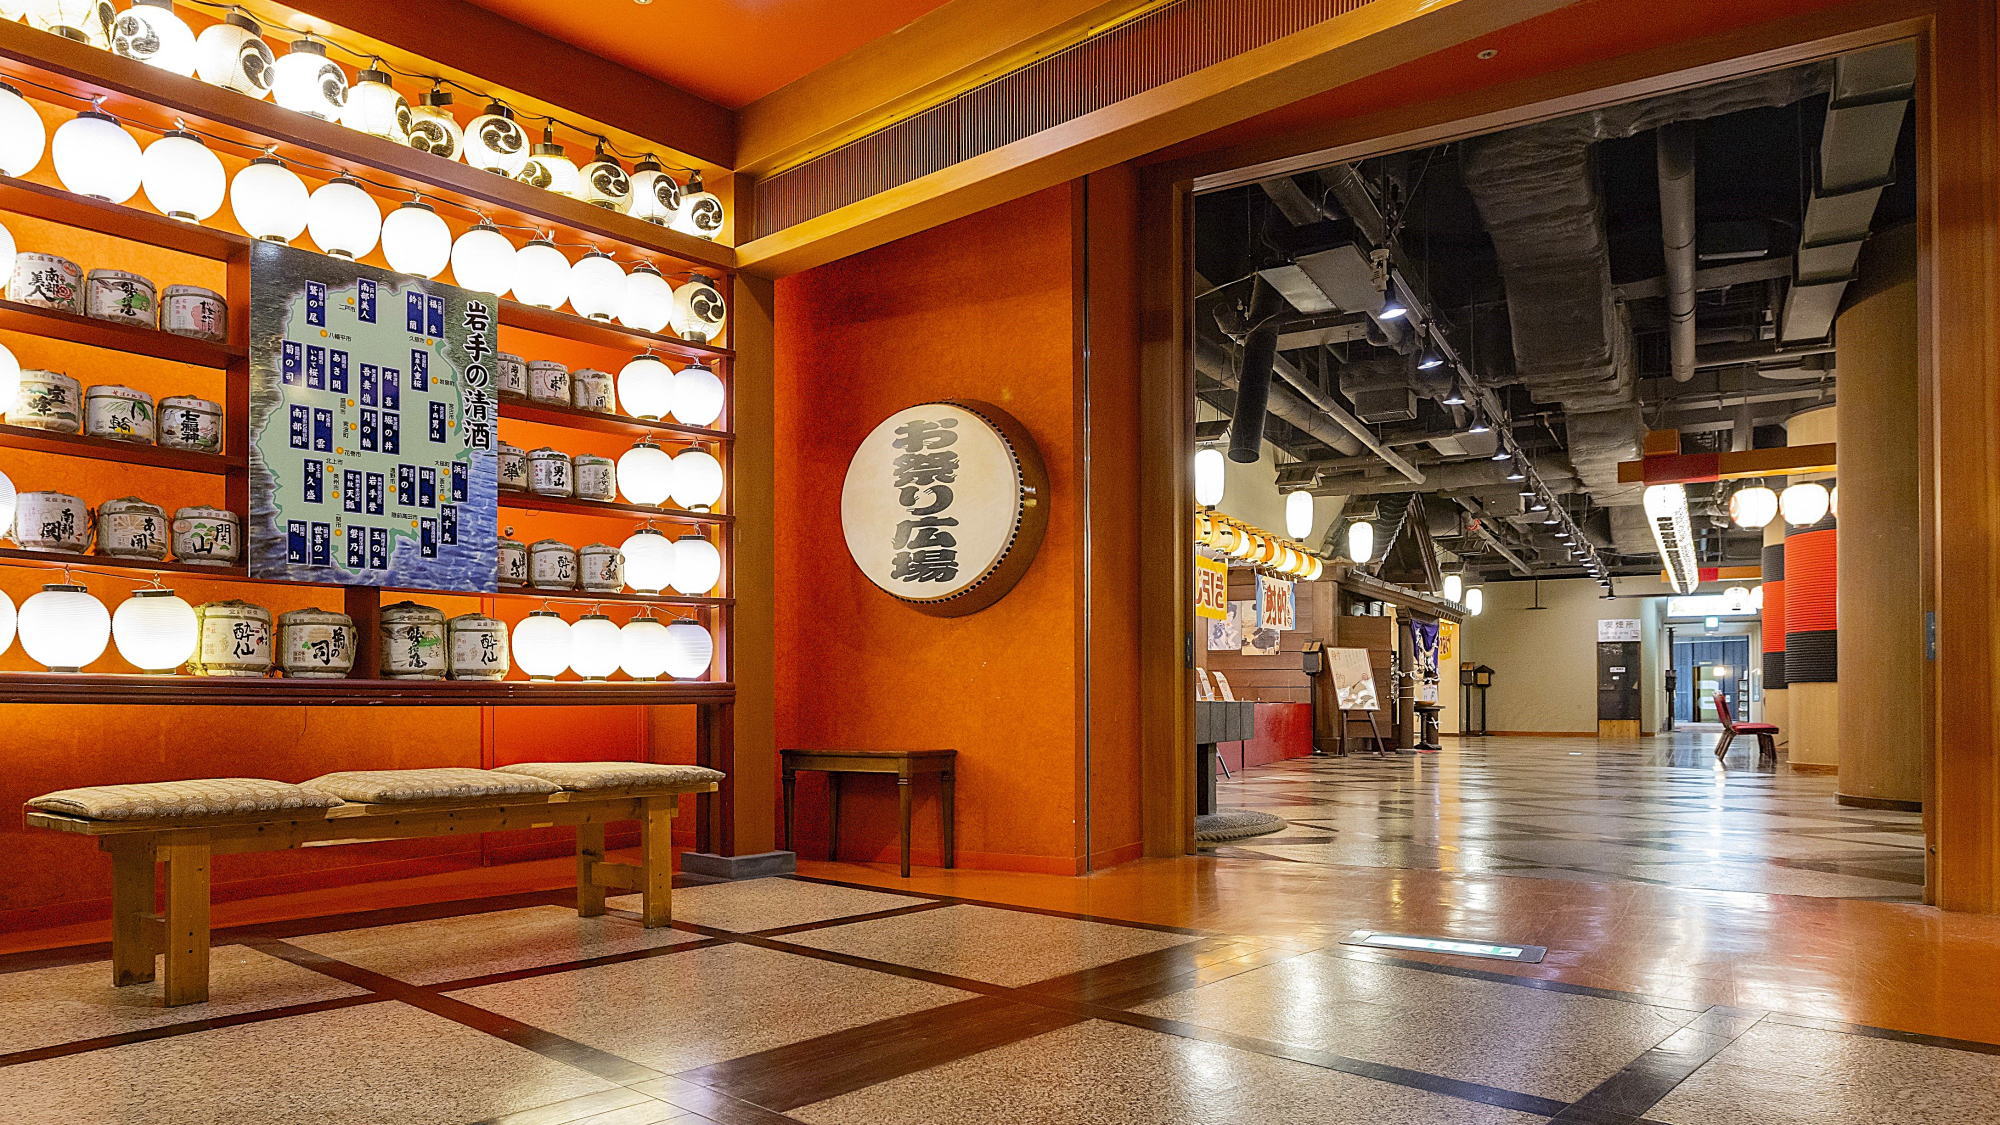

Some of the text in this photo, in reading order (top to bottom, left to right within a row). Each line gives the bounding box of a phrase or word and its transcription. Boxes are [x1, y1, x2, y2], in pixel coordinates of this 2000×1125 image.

[309, 285, 319, 323] 鷲の尾
[361, 282, 370, 319] 南部美人
[328, 332, 352, 342] 八幡平市
[285, 344, 295, 382] 菊の司
[308, 349, 318, 387] いわて桜顔
[332, 353, 341, 390] あさ開
[463, 300, 491, 451] 岩手の清酒
[362, 366, 372, 404] 吾妻嶺
[384, 370, 393, 407] 廣喜
[180, 409, 201, 443] 七福神
[292, 407, 302, 446] 南部関
[316, 411, 326, 449] 白雲
[362, 412, 372, 448] 月の輪
[384, 415, 393, 451] 堀の井
[431, 404, 440, 439] 千両男山
[325, 458, 343, 466] 北上市
[306, 462, 316, 500] 喜久盛
[368, 475, 377, 512] 岩手誉
[421, 469, 430, 504] 国華
[453, 465, 462, 499] 浜娘
[891, 417, 960, 582] お祭り広場
[290, 523, 300, 560] 関山
[422, 520, 432, 555] 酔仙
[442, 507, 452, 542] 浜千鳥
[372, 531, 381, 567] 玉の春
[232, 616, 256, 660] 酔仙
[480, 632, 498, 666] 酔仙
